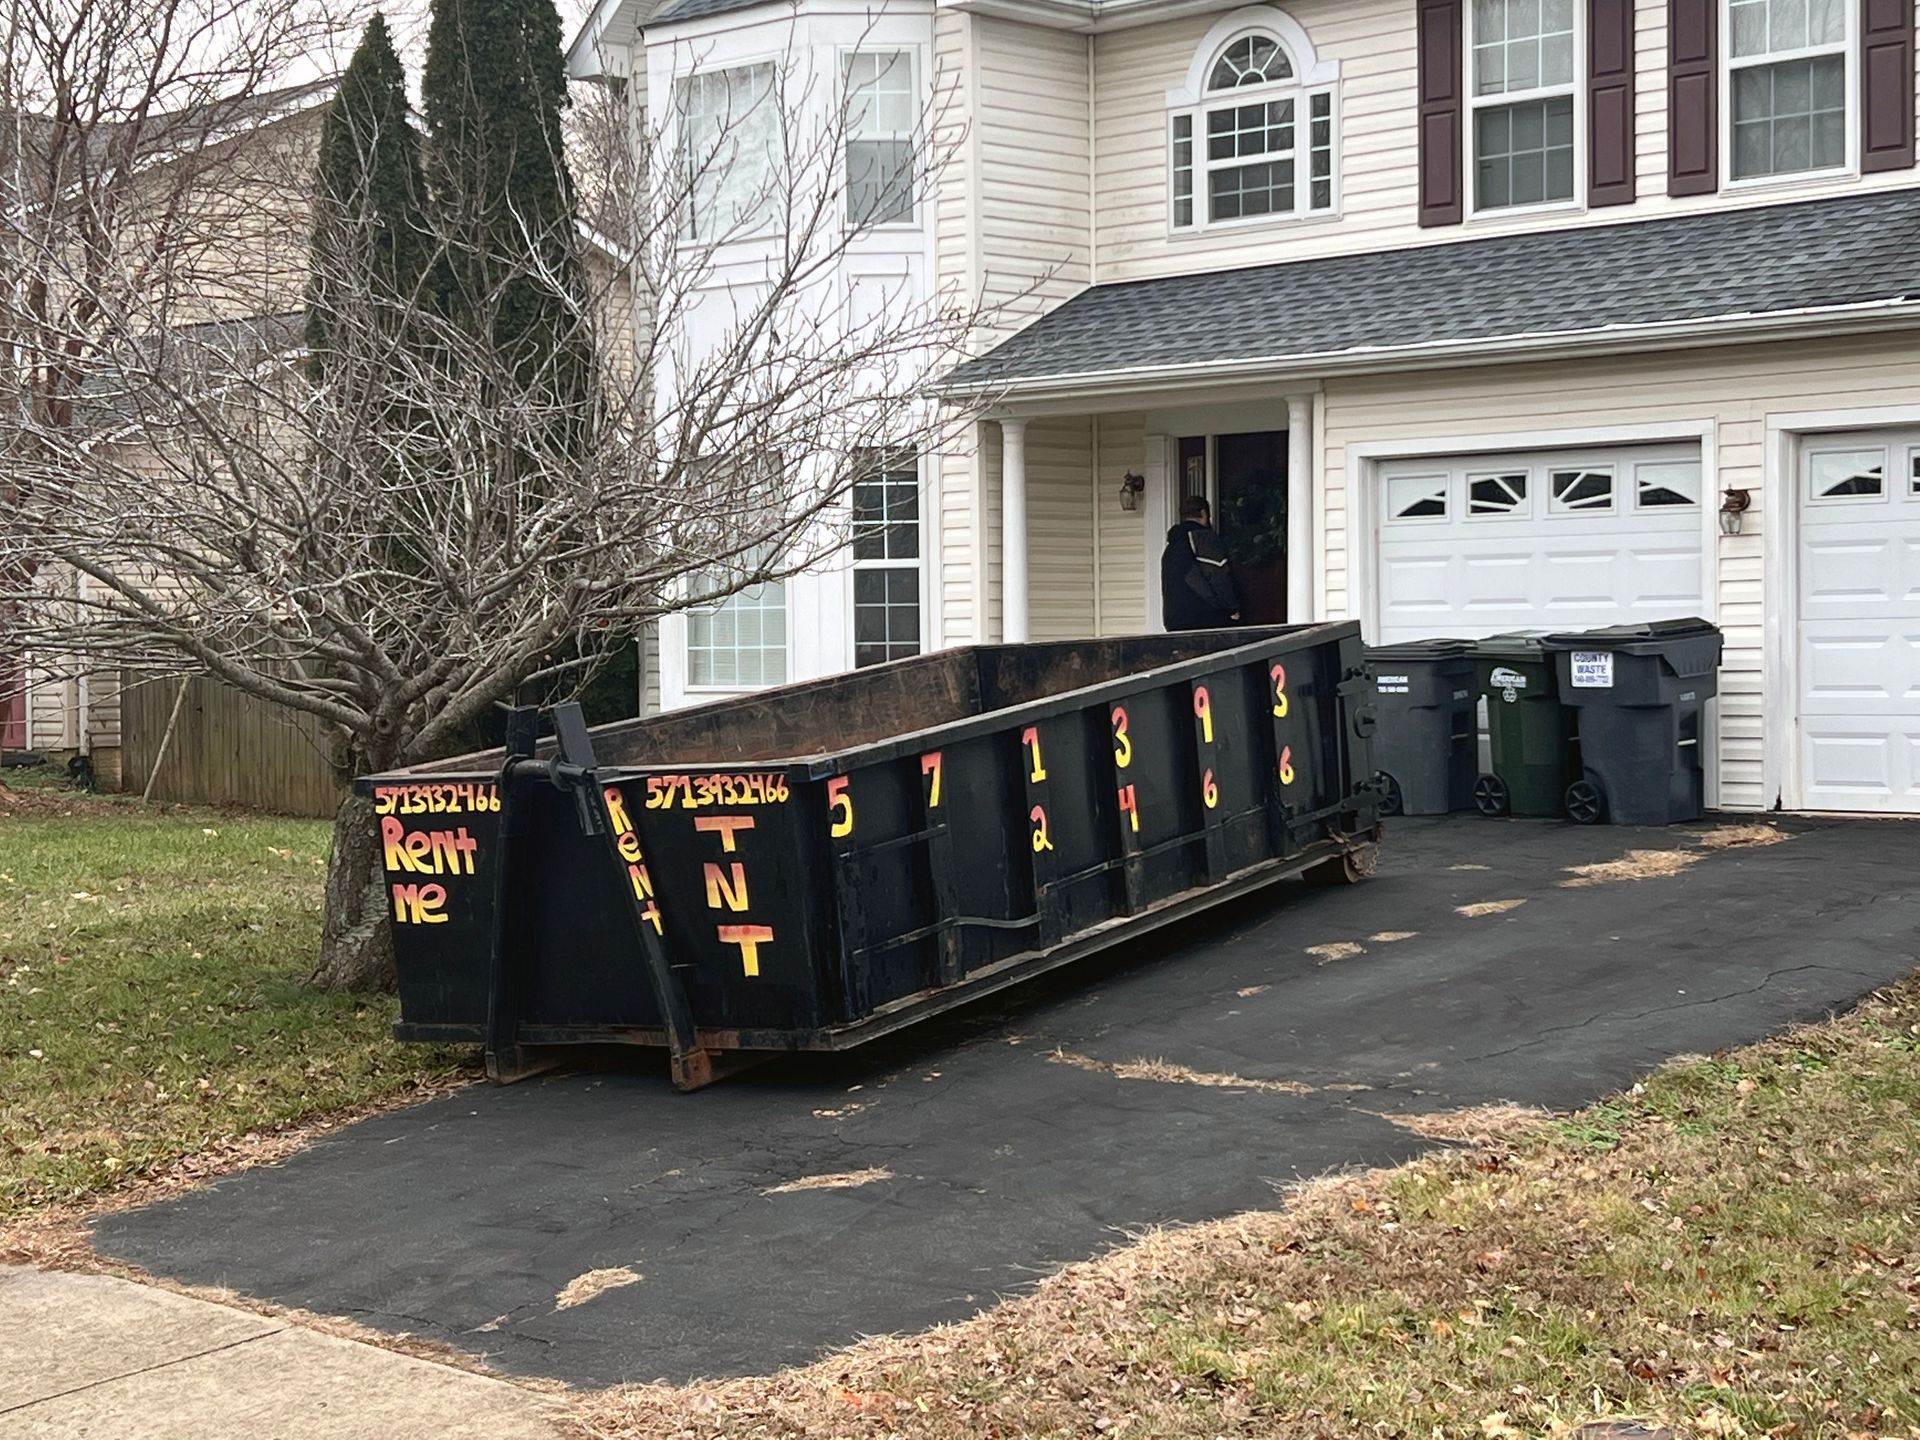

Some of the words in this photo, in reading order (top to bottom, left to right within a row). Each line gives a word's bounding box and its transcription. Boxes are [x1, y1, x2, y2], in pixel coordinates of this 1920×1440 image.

[1574, 652, 1609, 662] COUNTY
[1577, 664, 1607, 674] WASTE
[827, 776, 853, 838] 5
[921, 752, 942, 807] 7
[1022, 727, 1047, 783] 1
[1111, 707, 1132, 768] 3
[1193, 686, 1213, 743] 9
[1271, 664, 1288, 718] 3
[375, 784, 501, 814] 5713932466
[645, 774, 789, 809] 5713932466
[1029, 805, 1054, 852] 2
[1118, 784, 1139, 832] 4
[1203, 770, 1218, 808] 6
[1279, 745, 1294, 785] 6
